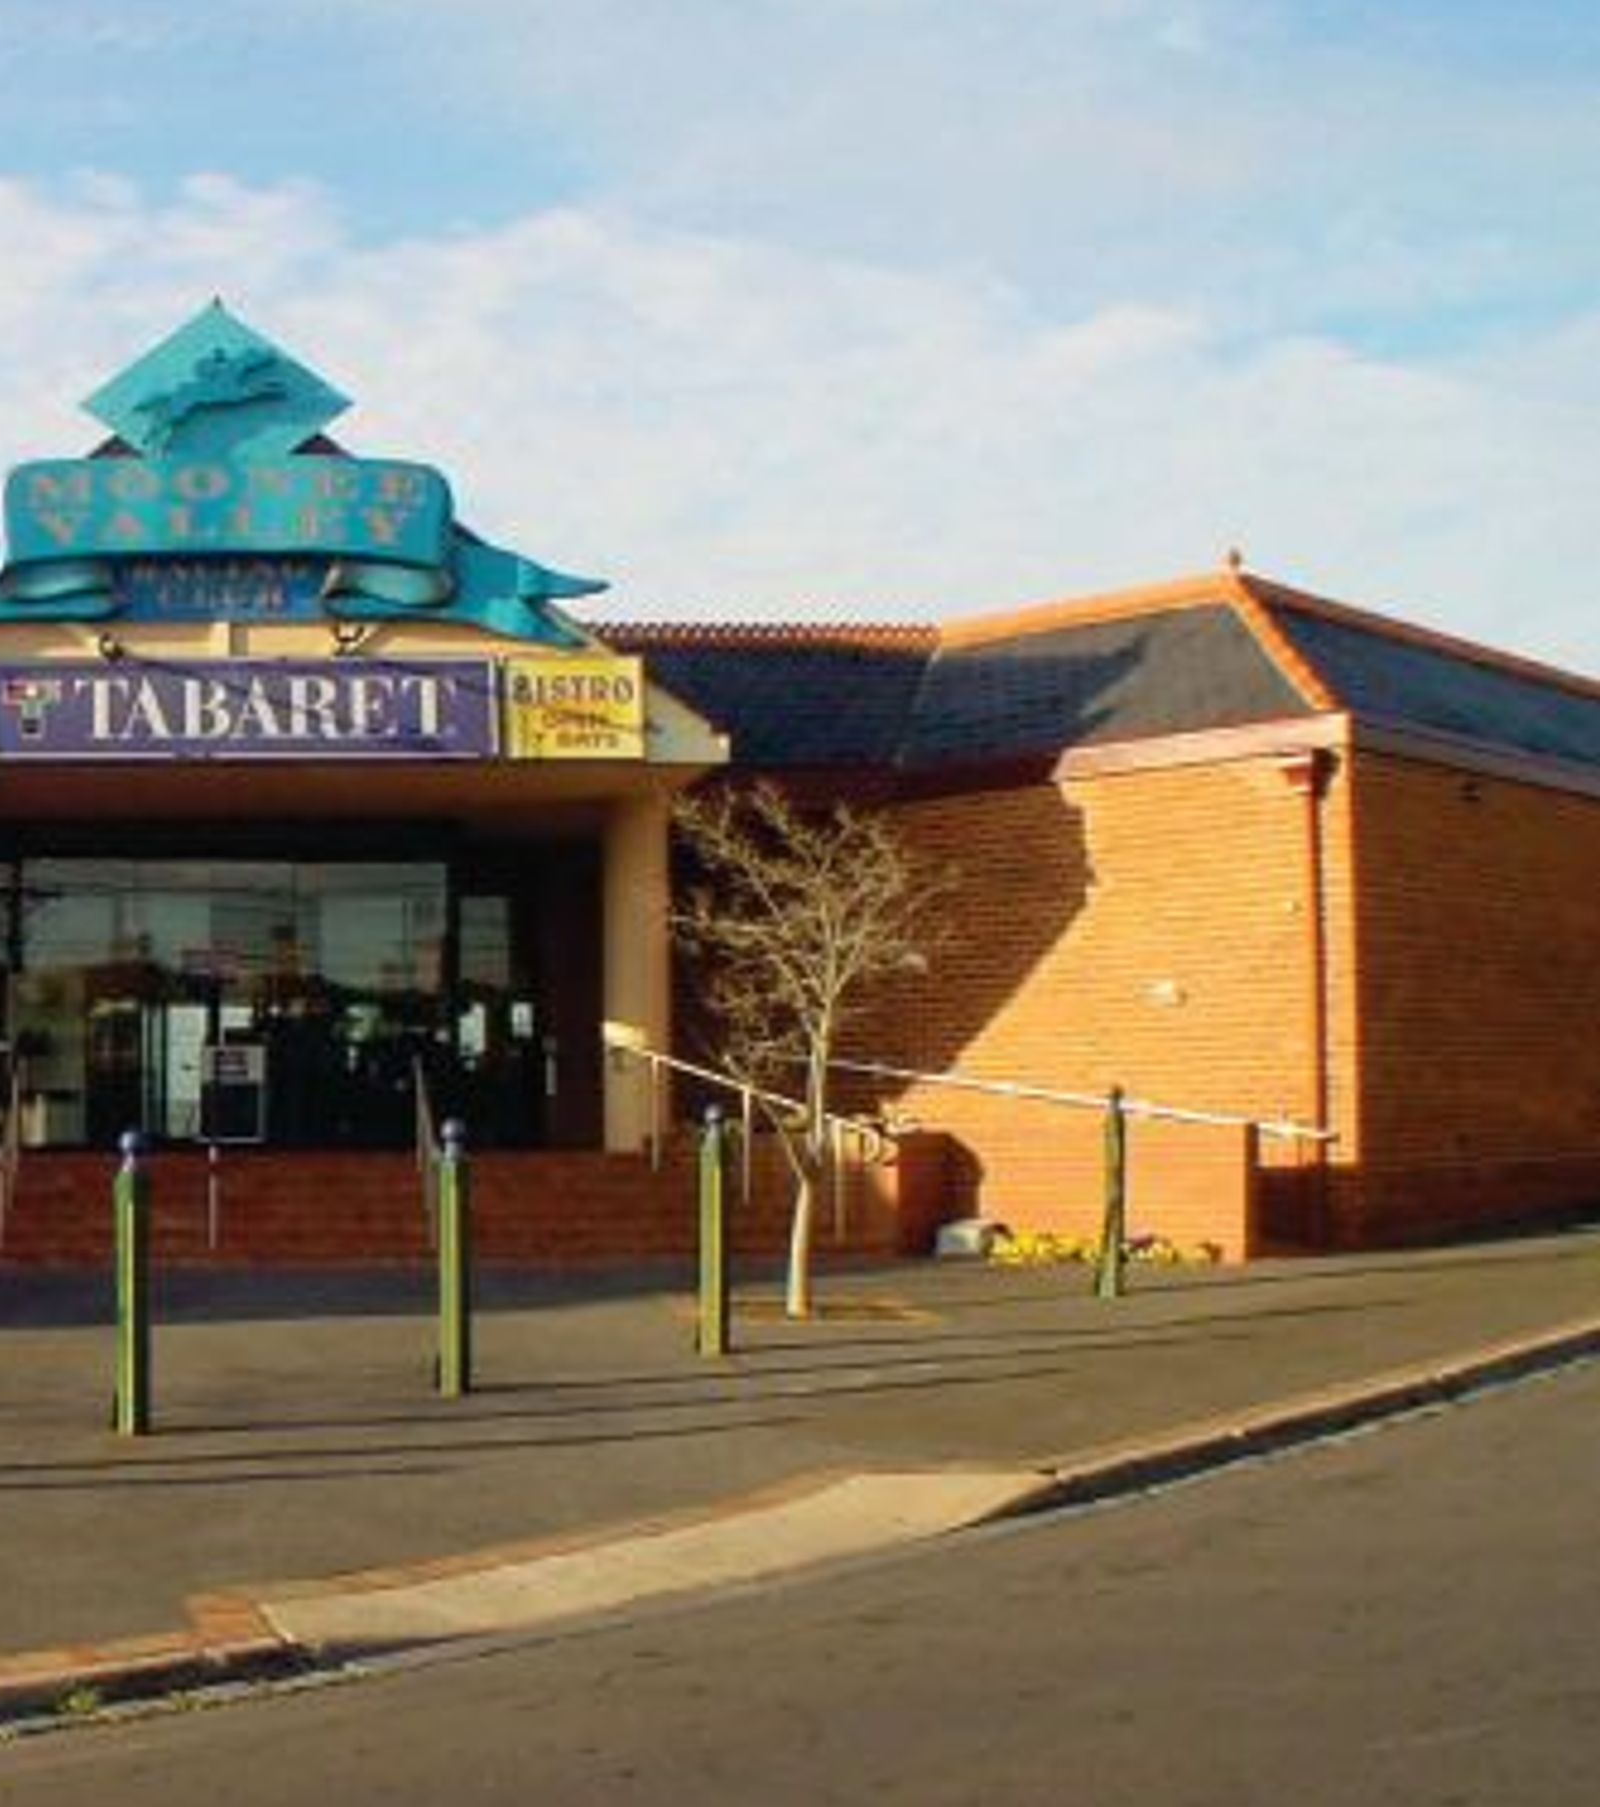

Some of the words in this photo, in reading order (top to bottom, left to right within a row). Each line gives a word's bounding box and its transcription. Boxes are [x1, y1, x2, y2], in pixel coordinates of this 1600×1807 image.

[24, 466, 428, 508] MOONEE
[32, 503, 408, 548] VALLEY
[74, 675, 457, 741] TABARET
[512, 674, 635, 705] BISTRO
